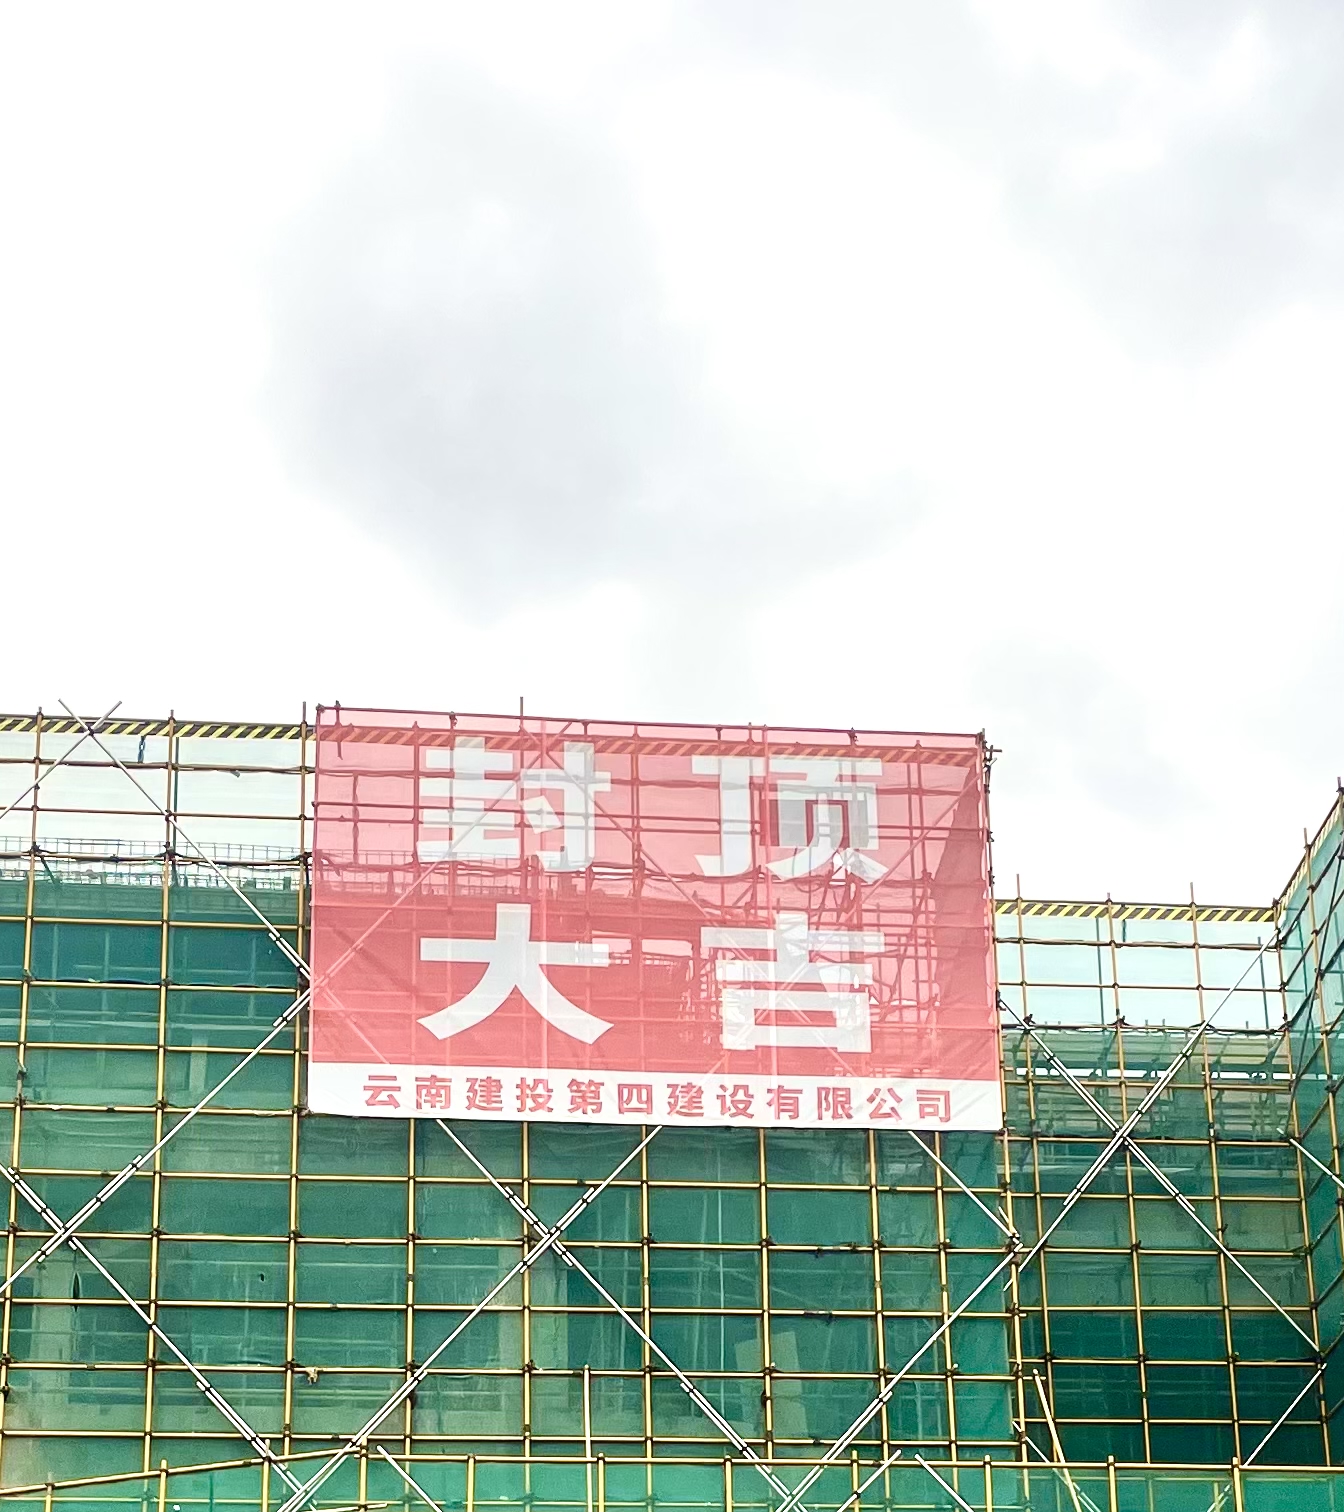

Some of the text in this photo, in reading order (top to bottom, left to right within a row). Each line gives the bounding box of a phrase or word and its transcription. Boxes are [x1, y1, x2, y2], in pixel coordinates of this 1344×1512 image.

[417, 736, 889, 884] 封顶
[417, 903, 885, 1053] 大吉
[362, 1074, 955, 1123] 云南建投第四建设有限公司
